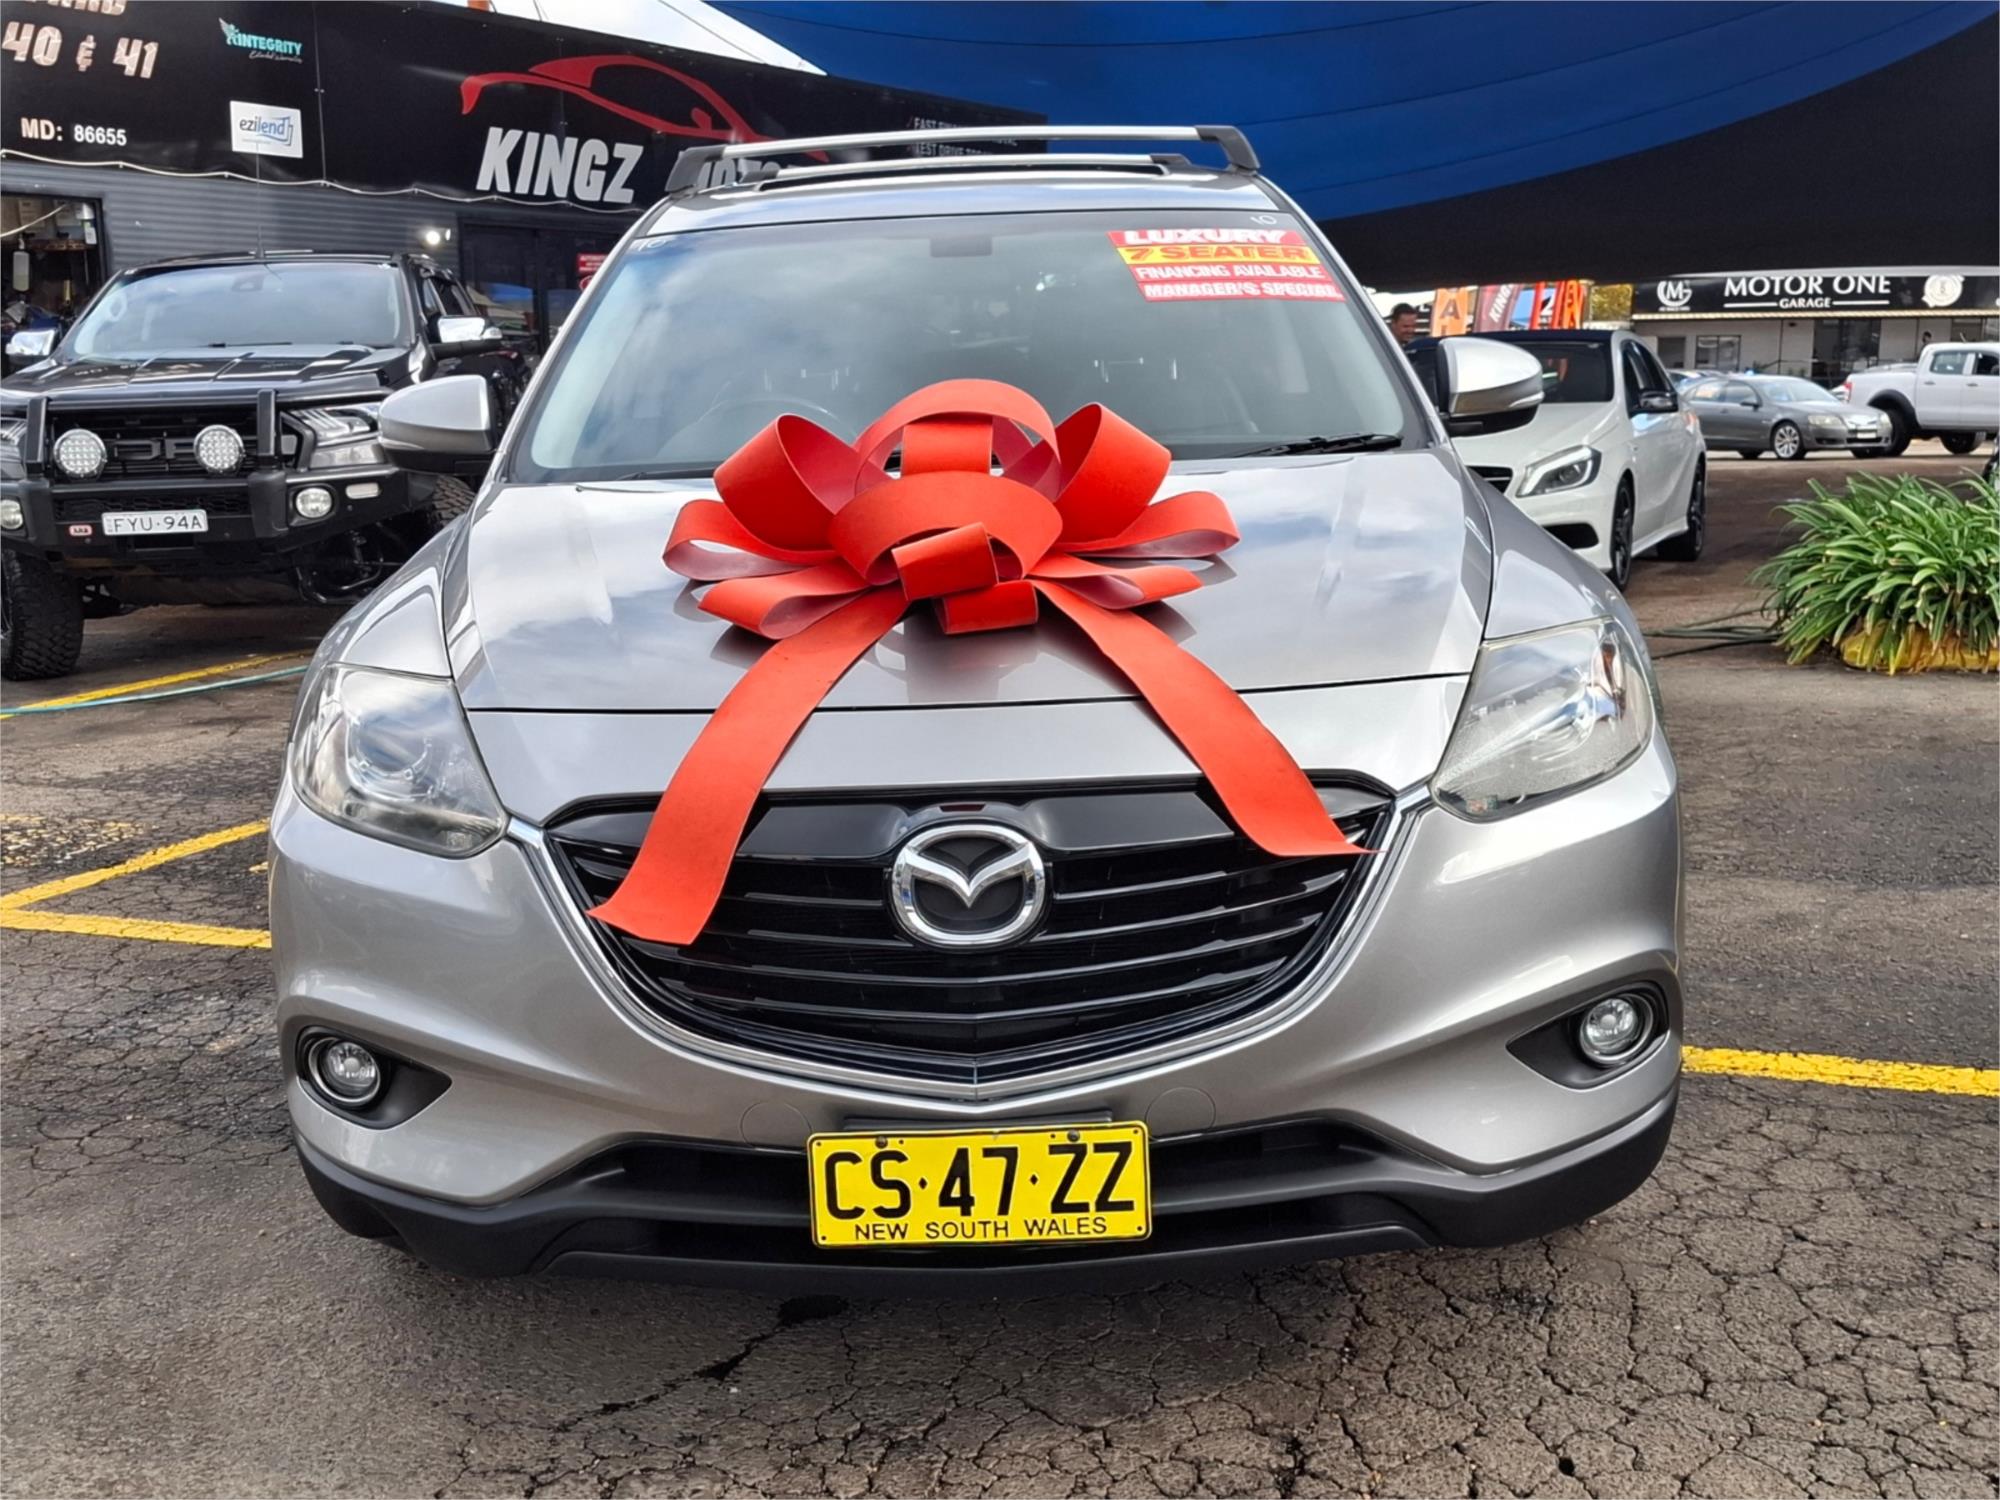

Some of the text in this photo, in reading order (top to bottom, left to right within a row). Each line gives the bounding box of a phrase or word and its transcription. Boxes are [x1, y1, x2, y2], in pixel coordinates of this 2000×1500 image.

[1, 21, 62, 66] 40
[112, 37, 159, 79] 41
[237, 33, 303, 56] INTEGRITY
[20, 117, 127, 147] MD: 86655
[239, 115, 285, 135] ezilend
[476, 126, 643, 204] KINGZ
[1124, 228, 1287, 245] LUXURY
[1125, 246, 1307, 260] 7 SEATER
[1136, 265, 1324, 279] FINANCING AVAILABLE
[1260, 282, 1344, 298] SPECIAL
[1724, 275, 1891, 297] MOTOR ONE
[1779, 297, 1832, 309] GARAGE
[855, 1217, 1107, 1240] NEW SOUTH WALES
